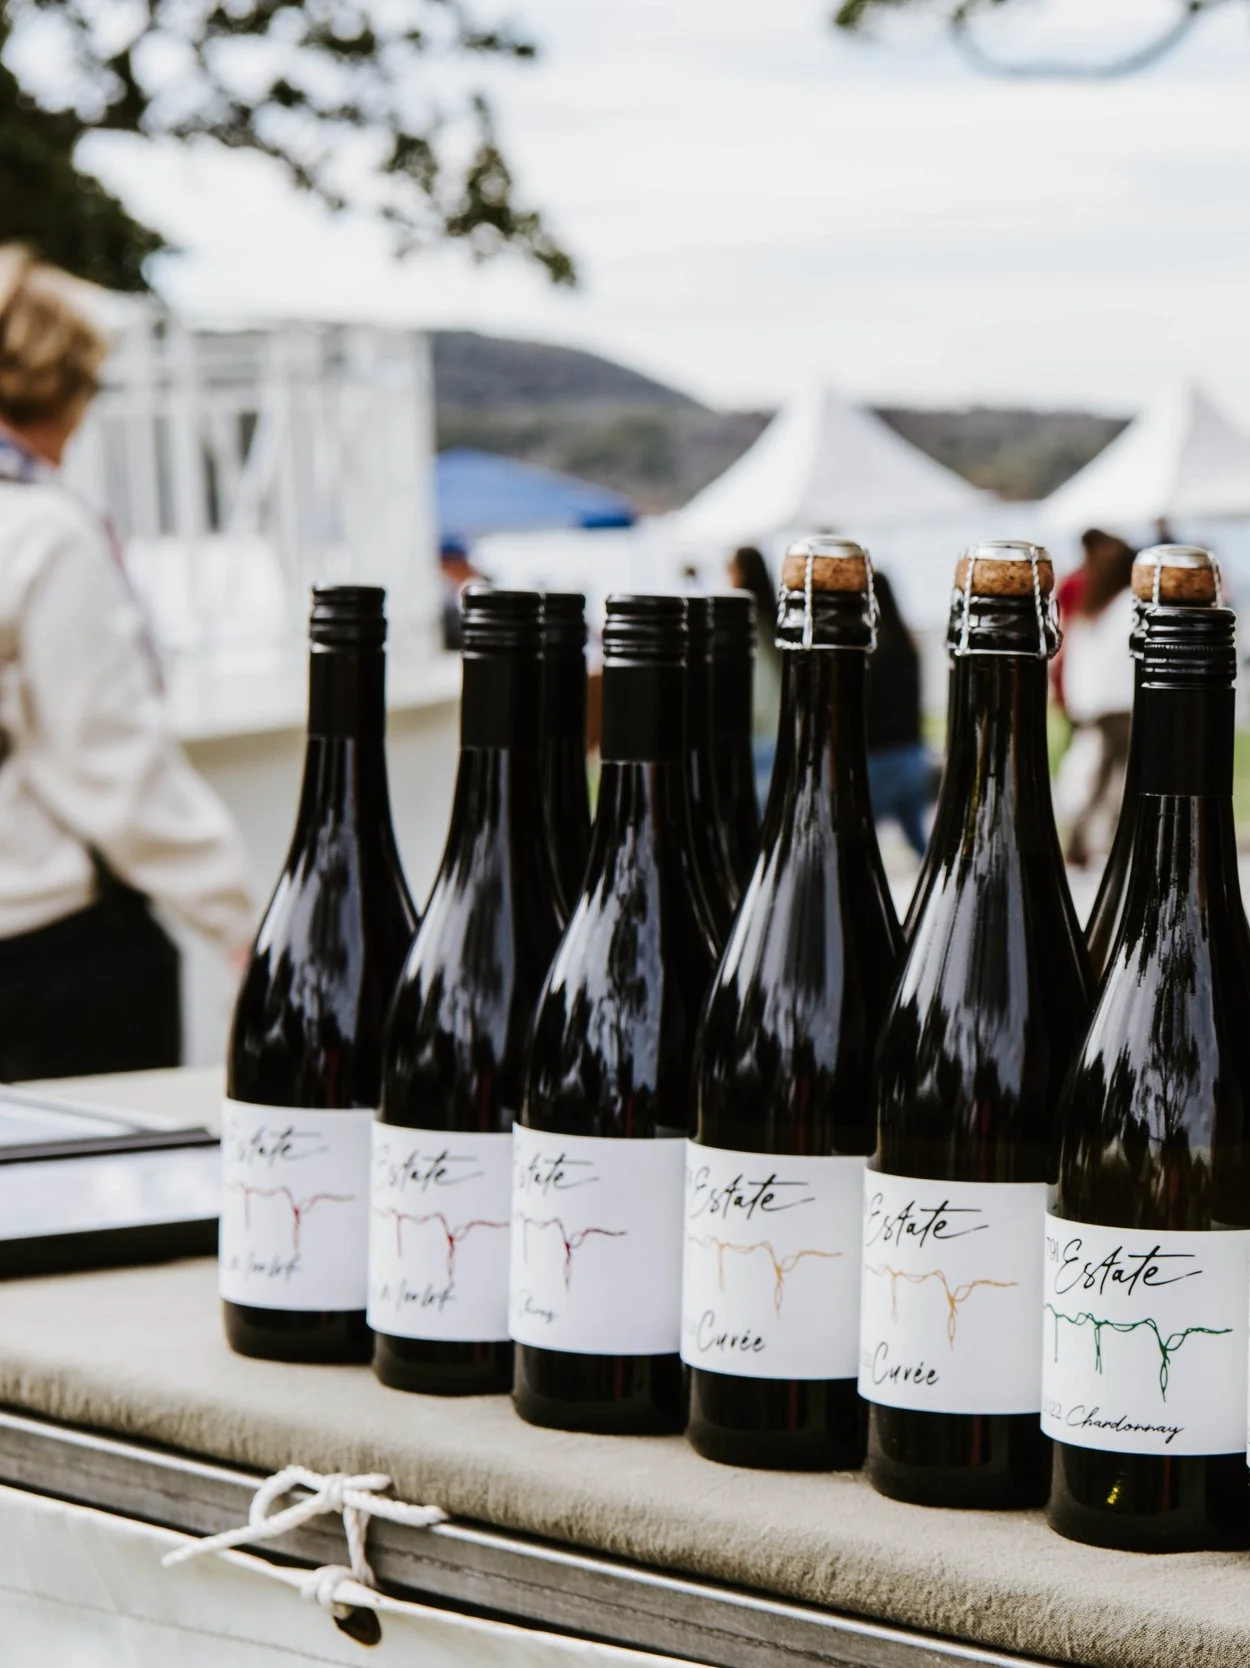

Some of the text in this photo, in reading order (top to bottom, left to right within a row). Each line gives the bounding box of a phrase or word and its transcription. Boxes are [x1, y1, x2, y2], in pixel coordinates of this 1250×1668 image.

[228, 1122, 331, 1167] state
[376, 1144, 487, 1191] state
[516, 1152, 600, 1195] state
[690, 1166, 815, 1219] Estate
[866, 1193, 989, 1247] Estate
[1055, 1238, 1202, 1296] Estate
[697, 1310, 766, 1352] Cuvée
[872, 1341, 940, 1385] Cuvée
[1066, 1405, 1184, 1444] Chardonnay
